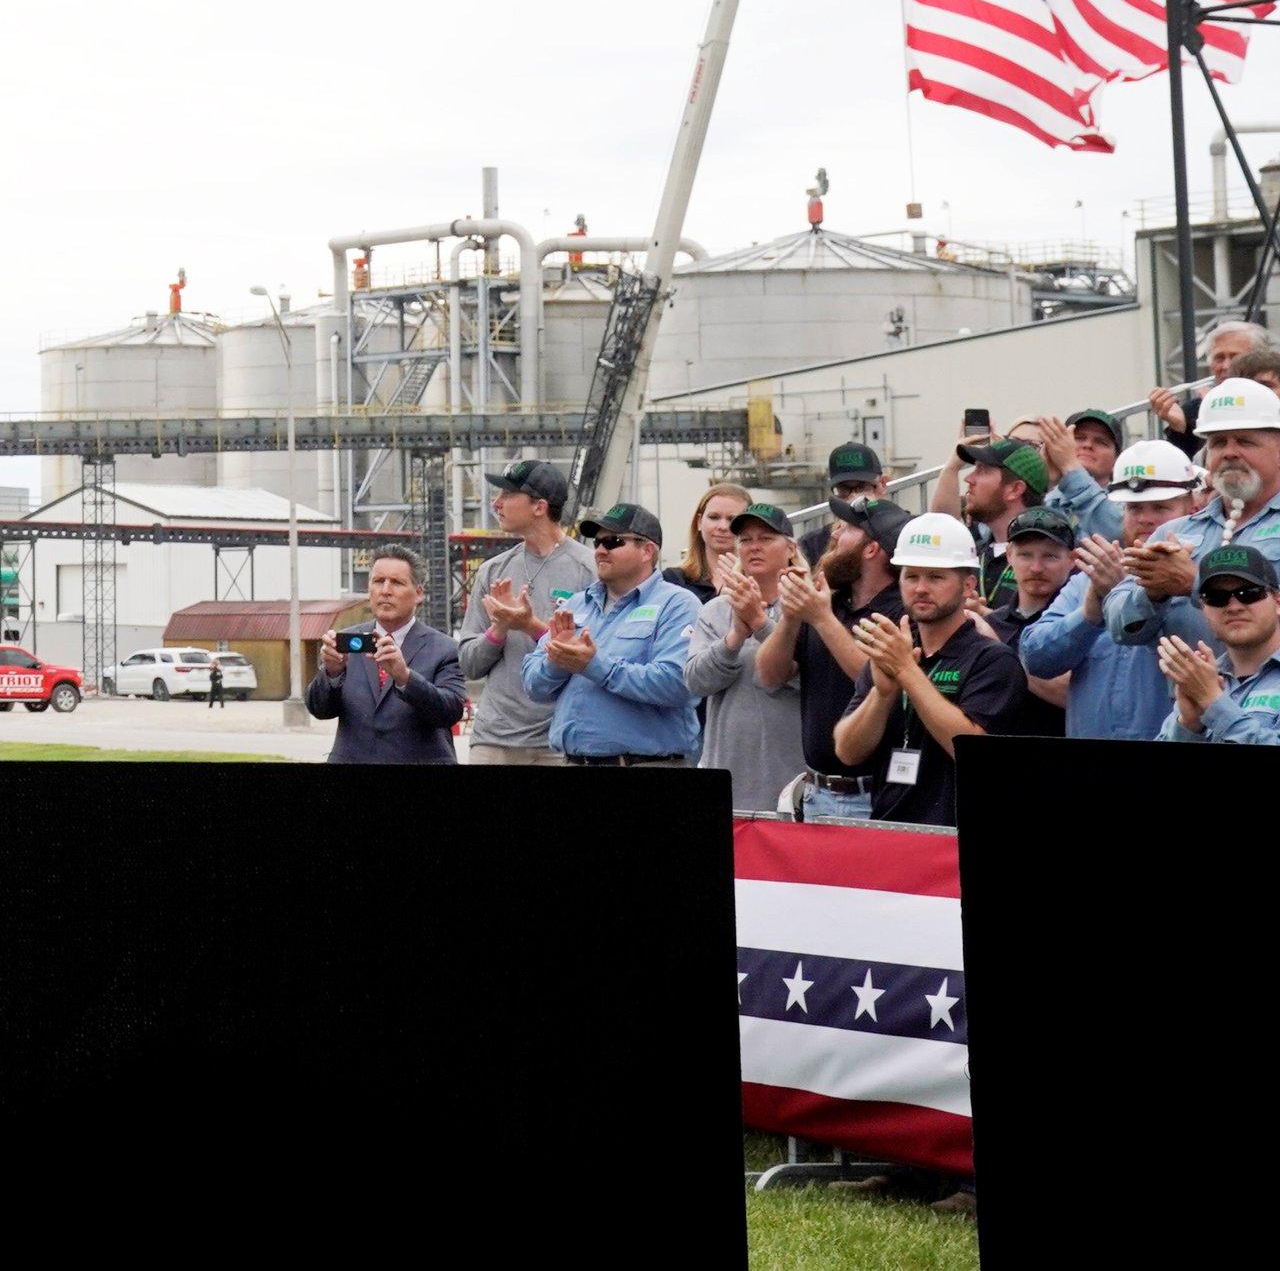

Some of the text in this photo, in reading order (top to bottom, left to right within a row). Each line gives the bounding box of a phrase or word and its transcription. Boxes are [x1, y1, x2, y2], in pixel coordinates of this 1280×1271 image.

[1210, 396, 1245, 408] SIRE
[1123, 465, 1155, 476] SIRE
[909, 534, 941, 546] SIRE
